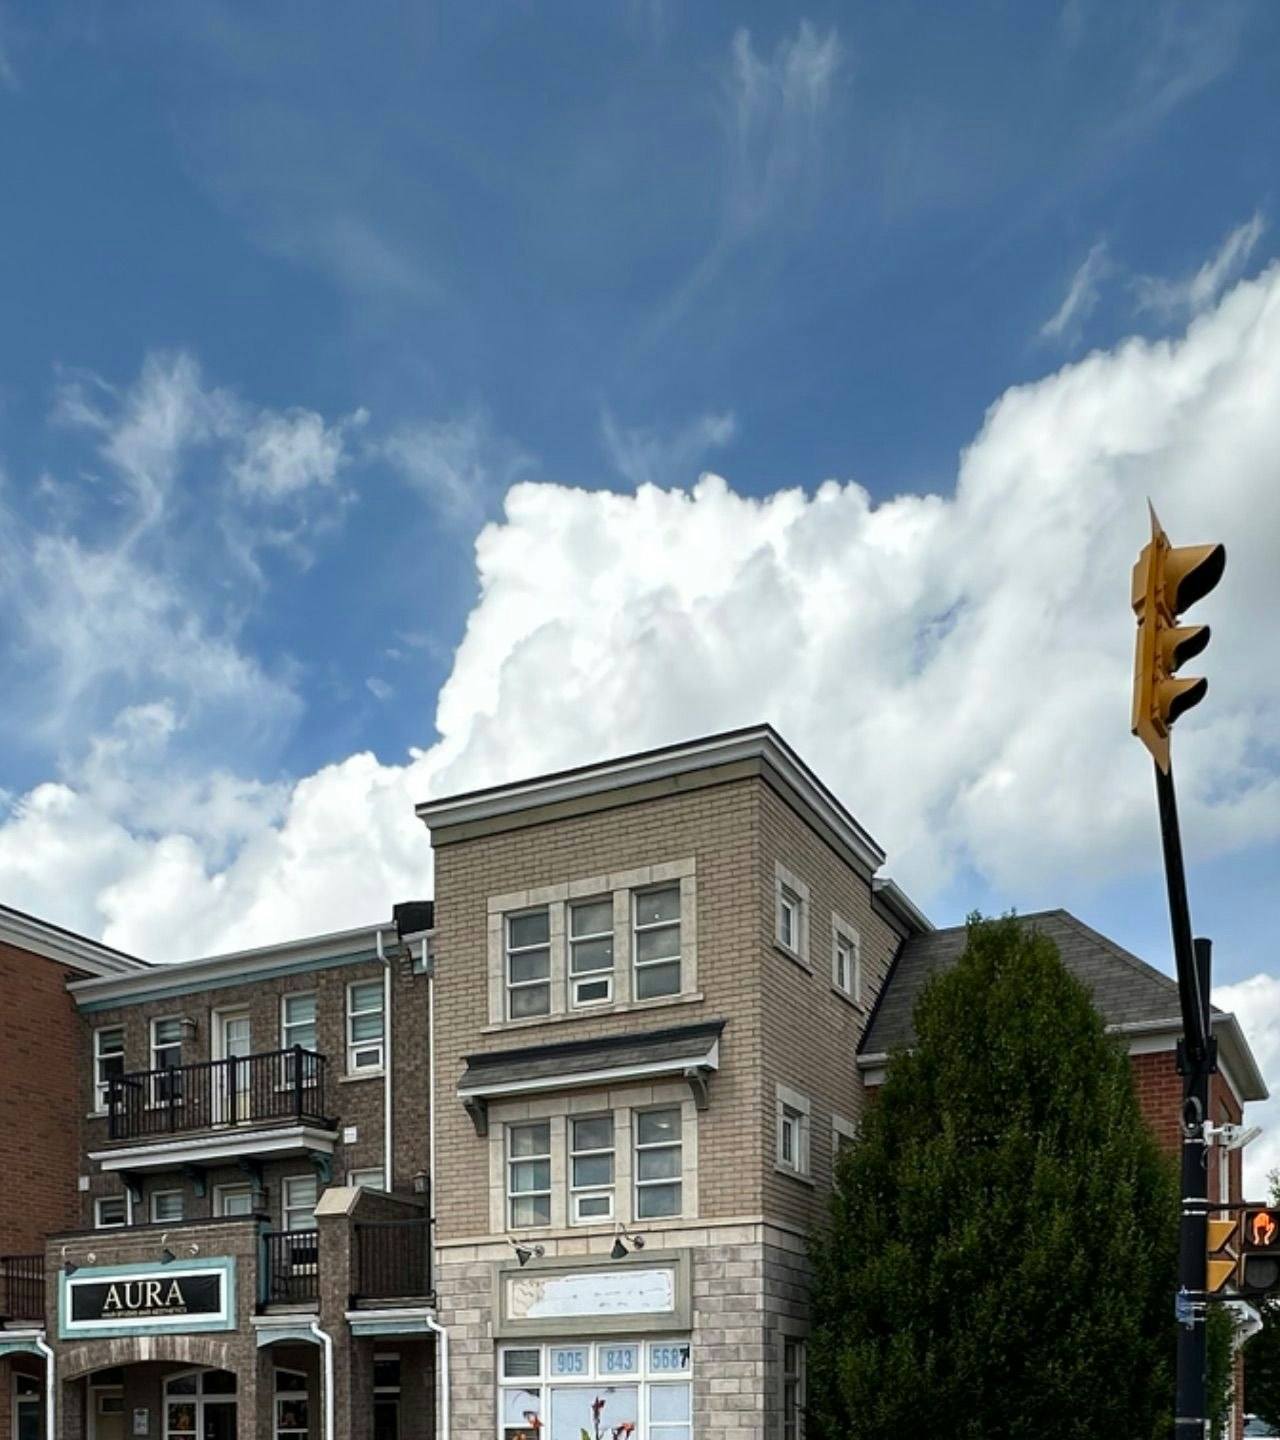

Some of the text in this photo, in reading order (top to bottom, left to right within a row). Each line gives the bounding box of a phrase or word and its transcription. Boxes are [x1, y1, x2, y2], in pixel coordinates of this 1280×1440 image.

[103, 1279, 186, 1310] AURA
[558, 1347, 689, 1372] 905 843 5687
